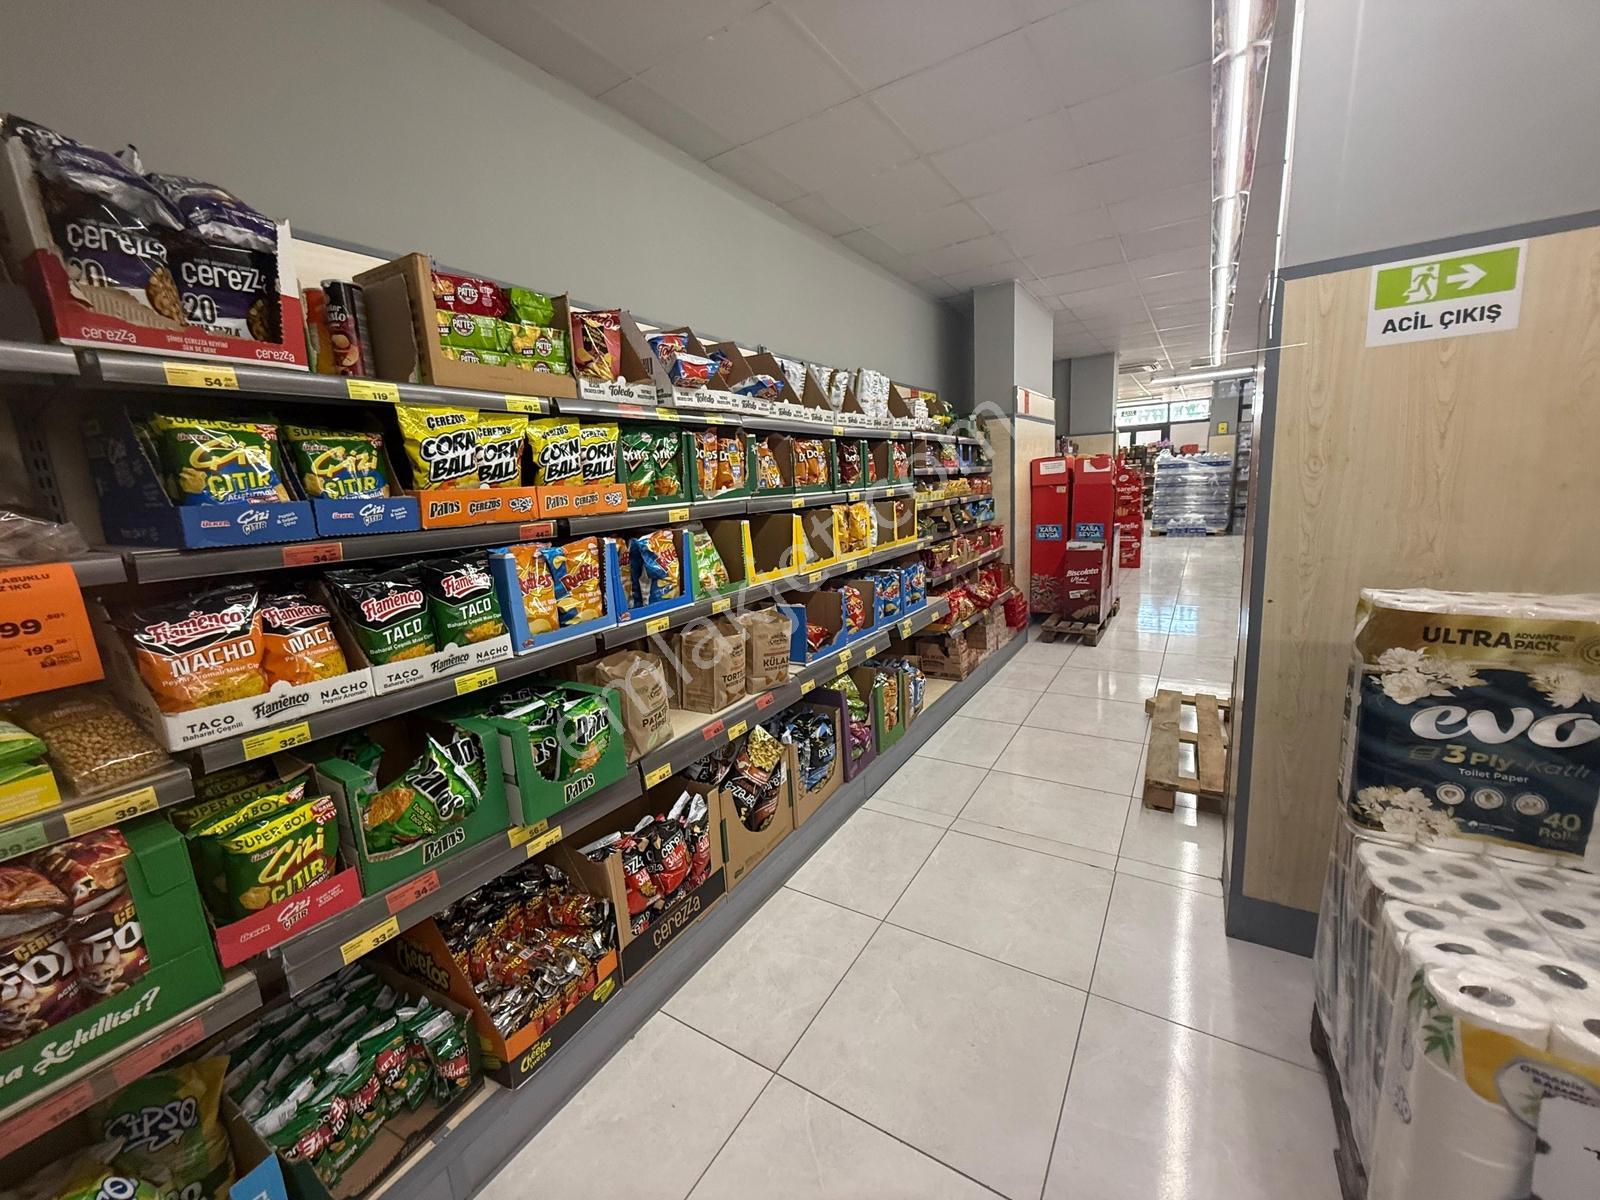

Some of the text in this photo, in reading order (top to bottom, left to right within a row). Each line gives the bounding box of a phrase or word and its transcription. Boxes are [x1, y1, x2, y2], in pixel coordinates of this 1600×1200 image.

[183, 292, 218, 325] 20
[1382, 304, 1502, 334] ACİL ÇIKIŞ
[81, 327, 137, 344] çerezza
[256, 348, 295, 363] çerezza
[204, 377, 222, 388] 54
[609, 385, 634, 398] Toledo
[372, 392, 388, 401] 119
[695, 391, 714, 404] Toledo
[742, 399, 757, 411] Toledo
[523, 404, 534, 413] 49
[427, 414, 467, 430] ÇEREZOS
[422, 431, 476, 458] CORN
[477, 440, 522, 462] CORN
[541, 439, 579, 464] CORN
[581, 442, 615, 462] CORN
[432, 452, 477, 479] BALL
[479, 459, 518, 481] BALL
[550, 458, 581, 479] BALL
[583, 460, 616, 479] BALL
[469, 498, 501, 514] ÇEREZOS
[574, 493, 599, 508] ÇEREZOS
[313, 555, 328, 563] 34
[262, 604, 331, 627] Flamenco
[361, 590, 423, 622] Flamenco
[459, 597, 491, 620] TACO
[288, 628, 335, 654] NACH
[383, 618, 422, 645] TACO
[1422, 626, 1513, 649] ULTRA
[1514, 632, 1575, 642] ADVANTAGE
[24, 644, 54, 656] 199
[476, 644, 509, 660] NACHO
[1514, 639, 1560, 653] PACK
[171, 640, 256, 678] NACHO
[431, 653, 470, 674] Flamenco
[387, 668, 419, 683] TACO
[477, 678, 488, 688] 32
[320, 680, 368, 700] NACHO
[253, 692, 310, 720] Flamenco
[187, 715, 236, 734] TACO
[1410, 705, 1600, 749] evo
[183, 729, 215, 743] Baharat
[279, 737, 296, 749] 32
[1443, 744, 1467, 763] 3
[1458, 768, 1529, 783] Toilet Paper
[115, 806, 138, 820] 39
[253, 799, 280, 817] BOY
[315, 809, 337, 826] ÇITI
[235, 812, 307, 851] SUPER BOY
[1543, 813, 1581, 832] 40
[258, 827, 325, 885] Çizi
[270, 858, 326, 903] ÇITIR
[414, 886, 428, 898] 34
[653, 895, 701, 950] çerezza
[372, 933, 386, 946] 33
[520, 1038, 552, 1073] Cheetos
